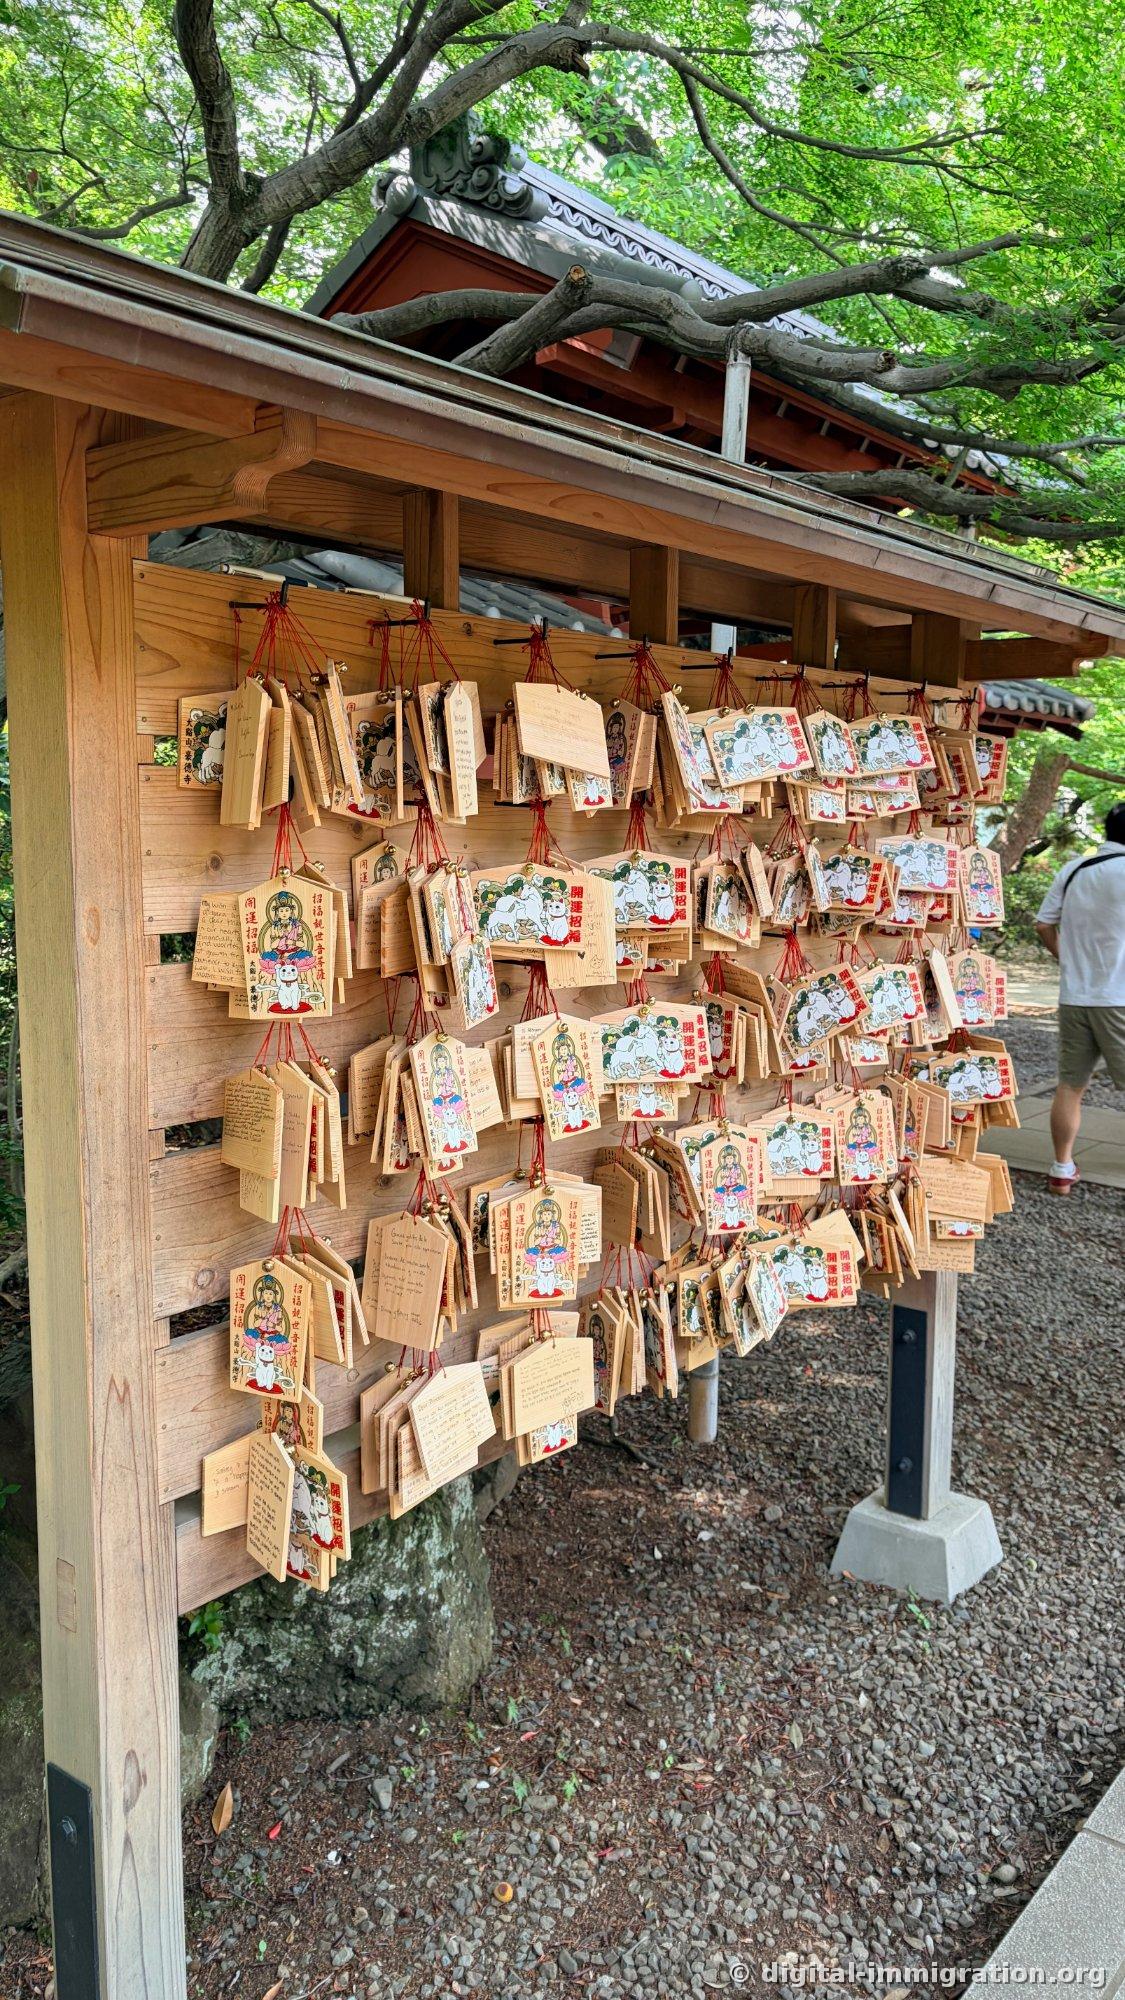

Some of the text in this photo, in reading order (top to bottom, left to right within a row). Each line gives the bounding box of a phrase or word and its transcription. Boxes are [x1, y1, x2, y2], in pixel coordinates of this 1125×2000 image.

[674, 867, 687, 921] 開運招福
[865, 862, 882, 904] 開運招福
[947, 850, 957, 888] 開運招福
[244, 896, 259, 955] 開運招福
[568, 885, 584, 943] 開運招福
[682, 1021, 697, 1074] 開運招福
[821, 1127, 832, 1172] 開運招福
[515, 1202, 526, 1250] 開運招福
[233, 1274, 246, 1329] 開運招福
[826, 1252, 838, 1299] 開運招福
[330, 1482, 344, 1550] 開運招福
